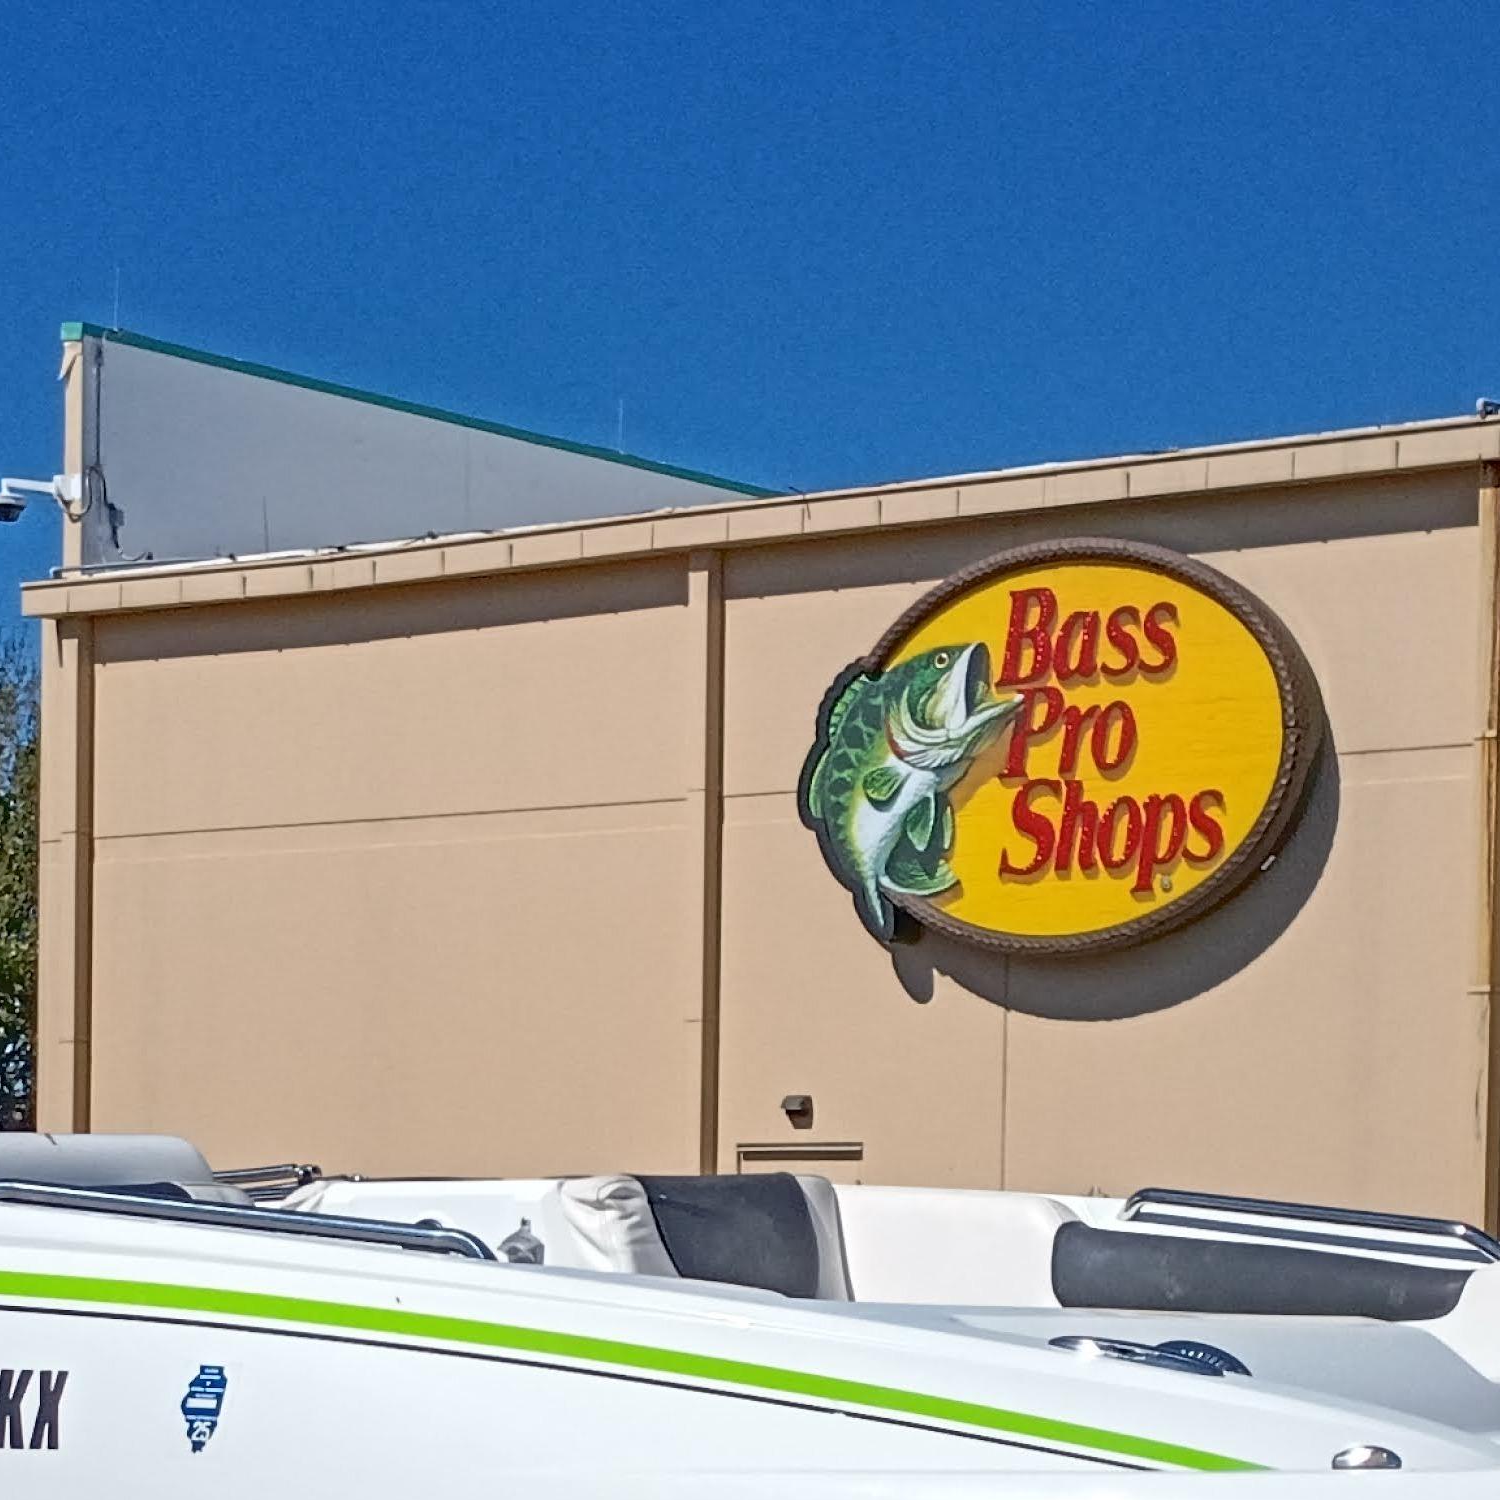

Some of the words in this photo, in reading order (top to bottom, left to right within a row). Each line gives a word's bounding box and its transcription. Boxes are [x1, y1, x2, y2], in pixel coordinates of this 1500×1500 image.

[996, 586, 1180, 687] Bass
[998, 687, 1137, 779] Pro
[1000, 779, 1226, 893] Shops
[191, 1420, 213, 1442] 25
